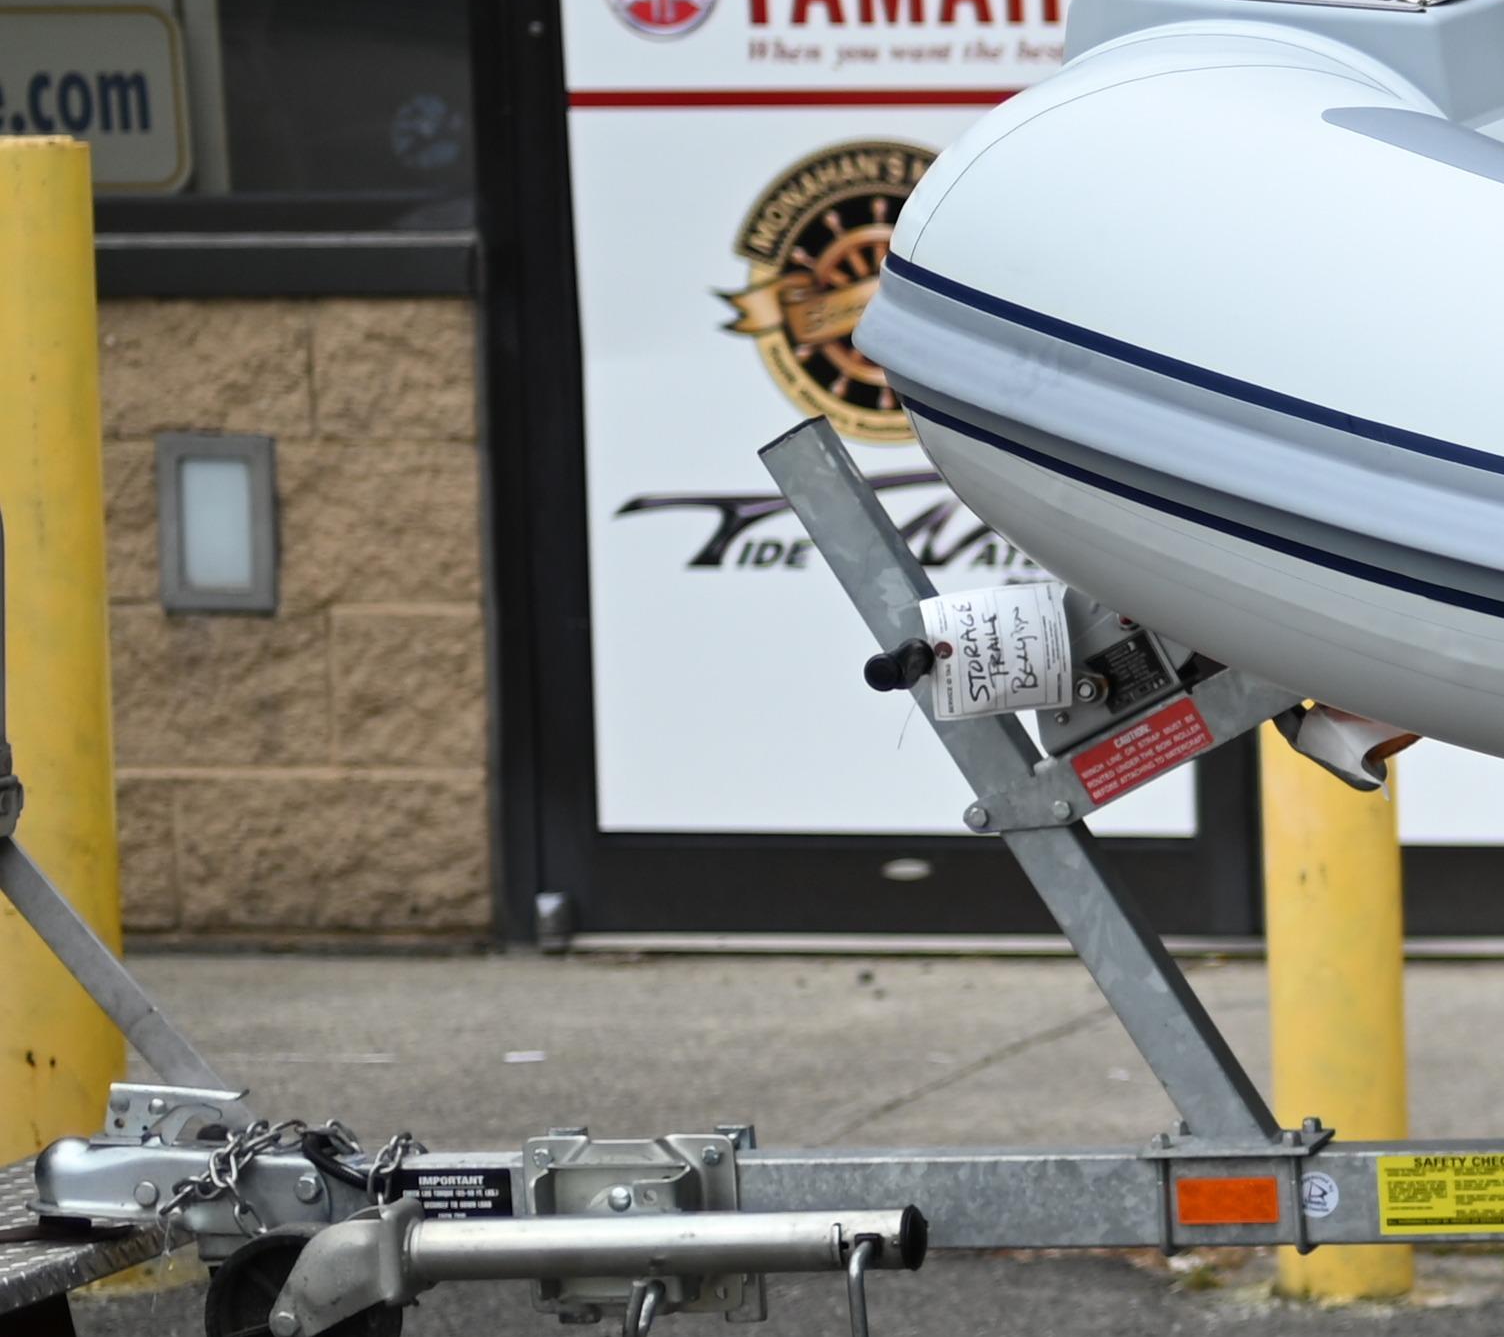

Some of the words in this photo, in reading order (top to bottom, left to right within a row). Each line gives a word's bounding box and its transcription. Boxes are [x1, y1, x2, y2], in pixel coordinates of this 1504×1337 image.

[0, 71, 151, 134] .com
[953, 601, 991, 702] STORAGE
[418, 1175, 484, 1185] IMPORTANT
[1414, 1156, 1466, 1168] SAFETY
